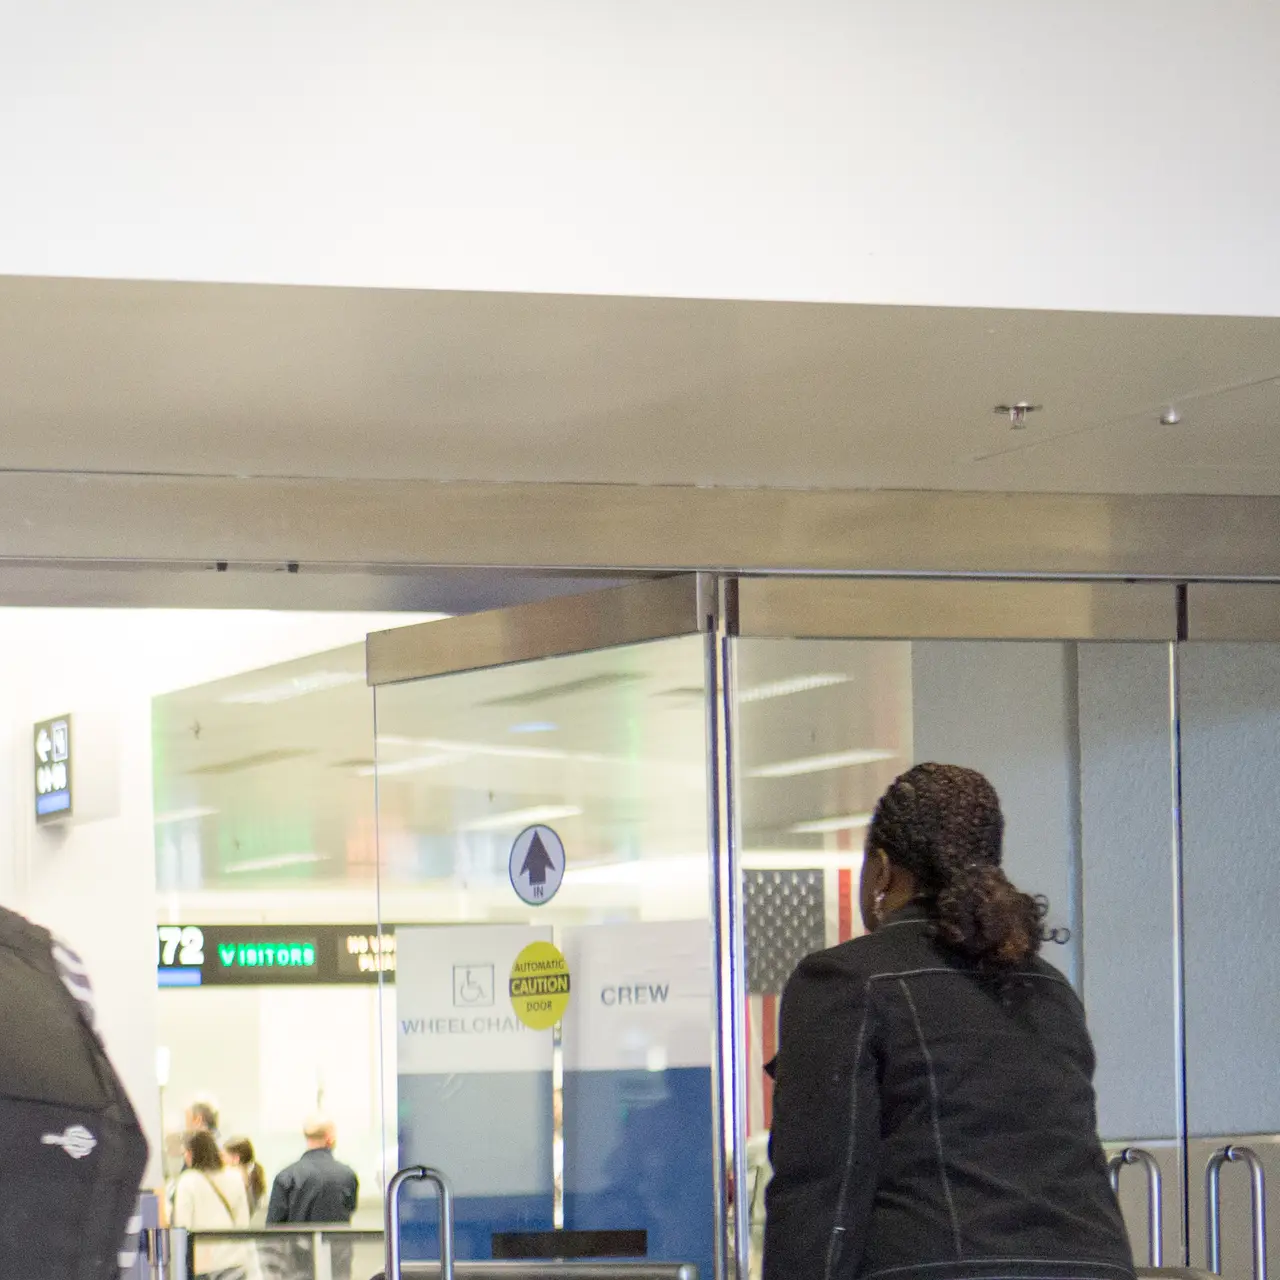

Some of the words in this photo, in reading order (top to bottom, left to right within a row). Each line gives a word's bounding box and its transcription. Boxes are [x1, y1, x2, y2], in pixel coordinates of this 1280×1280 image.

[532, 886, 544, 898] IN
[217, 943, 316, 967] VISITORS
[514, 959, 565, 973] AUTOMATIC
[511, 976, 569, 996] CAUTION
[600, 984, 670, 1007] CREW
[526, 1001, 553, 1013] DOOR
